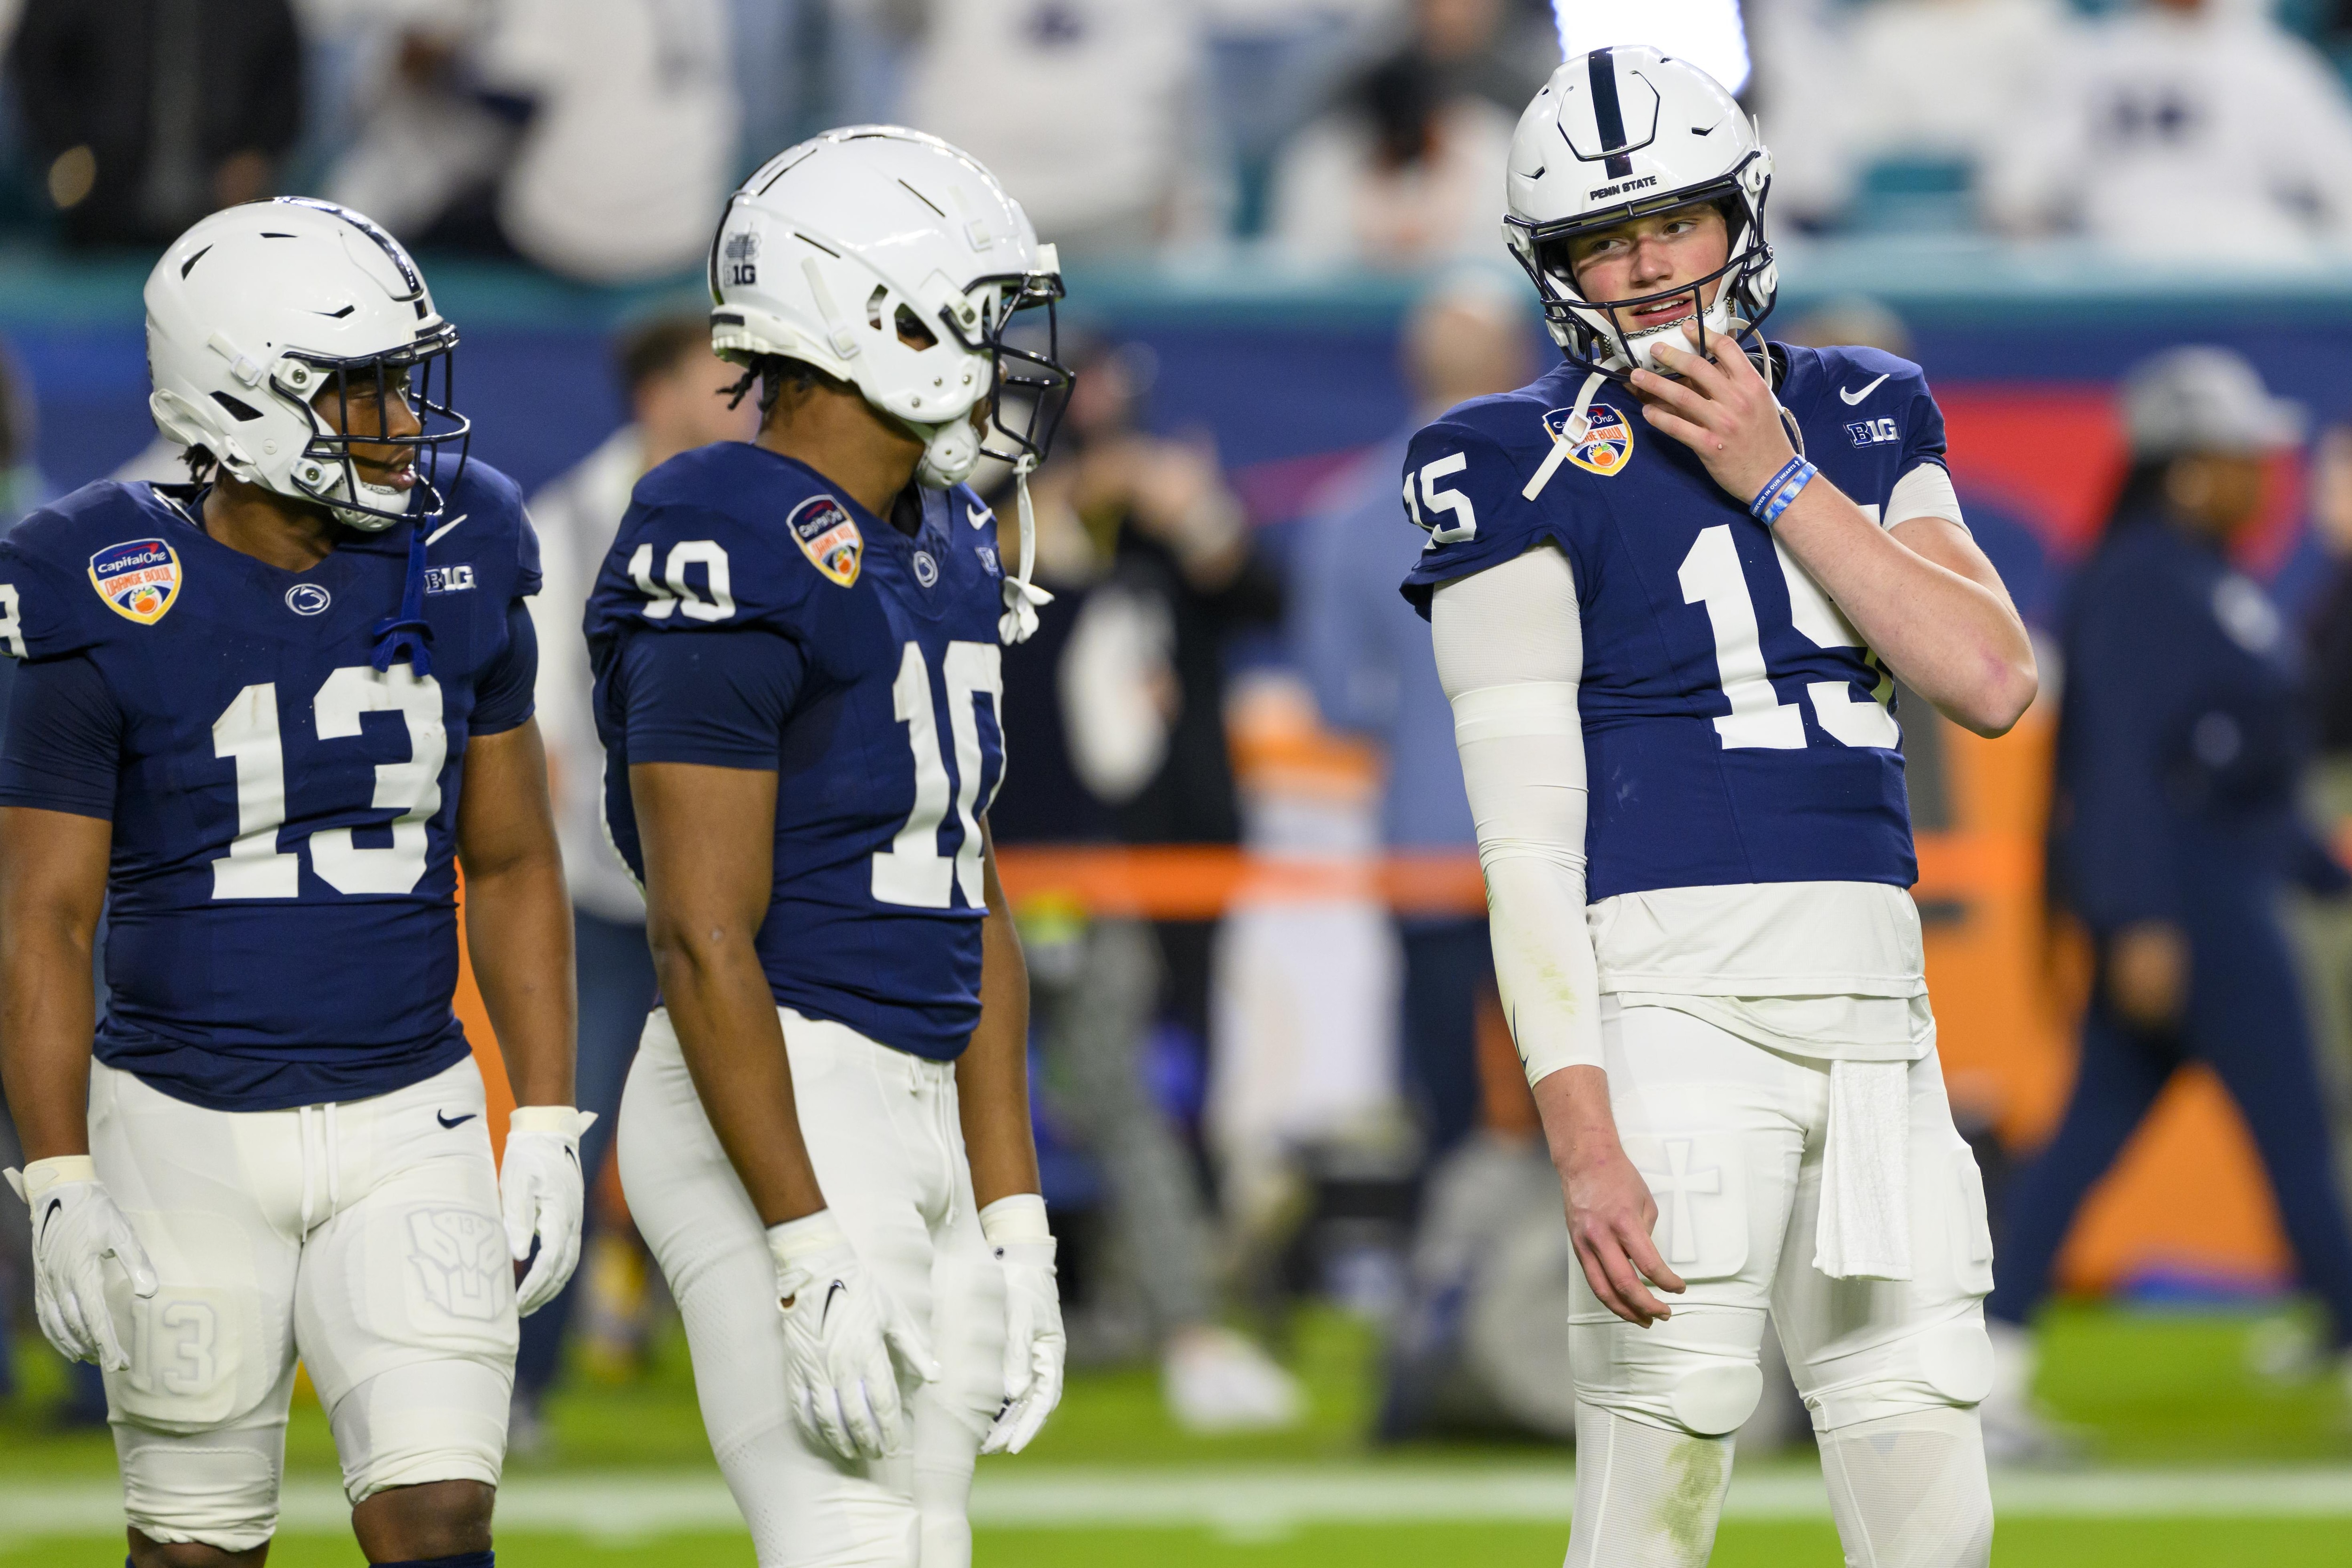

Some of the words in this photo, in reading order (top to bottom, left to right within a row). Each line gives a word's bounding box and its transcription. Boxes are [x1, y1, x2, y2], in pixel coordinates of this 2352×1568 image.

[1590, 185, 1620, 200] PENN
[1622, 175, 1657, 192] STATE
[1597, 426, 1627, 440] BOWL
[1403, 451, 1477, 549] 15
[1753, 495, 1766, 515] FOREVER
[1770, 479, 1781, 490] OUR
[1780, 464, 1796, 480] HEARTS
[104, 573, 143, 597] ORANGE
[143, 566, 175, 582] BOWL
[628, 540, 736, 622] 10
[211, 662, 447, 899] 13
[871, 640, 1007, 908] 10
[129, 1298, 216, 1396] 13
